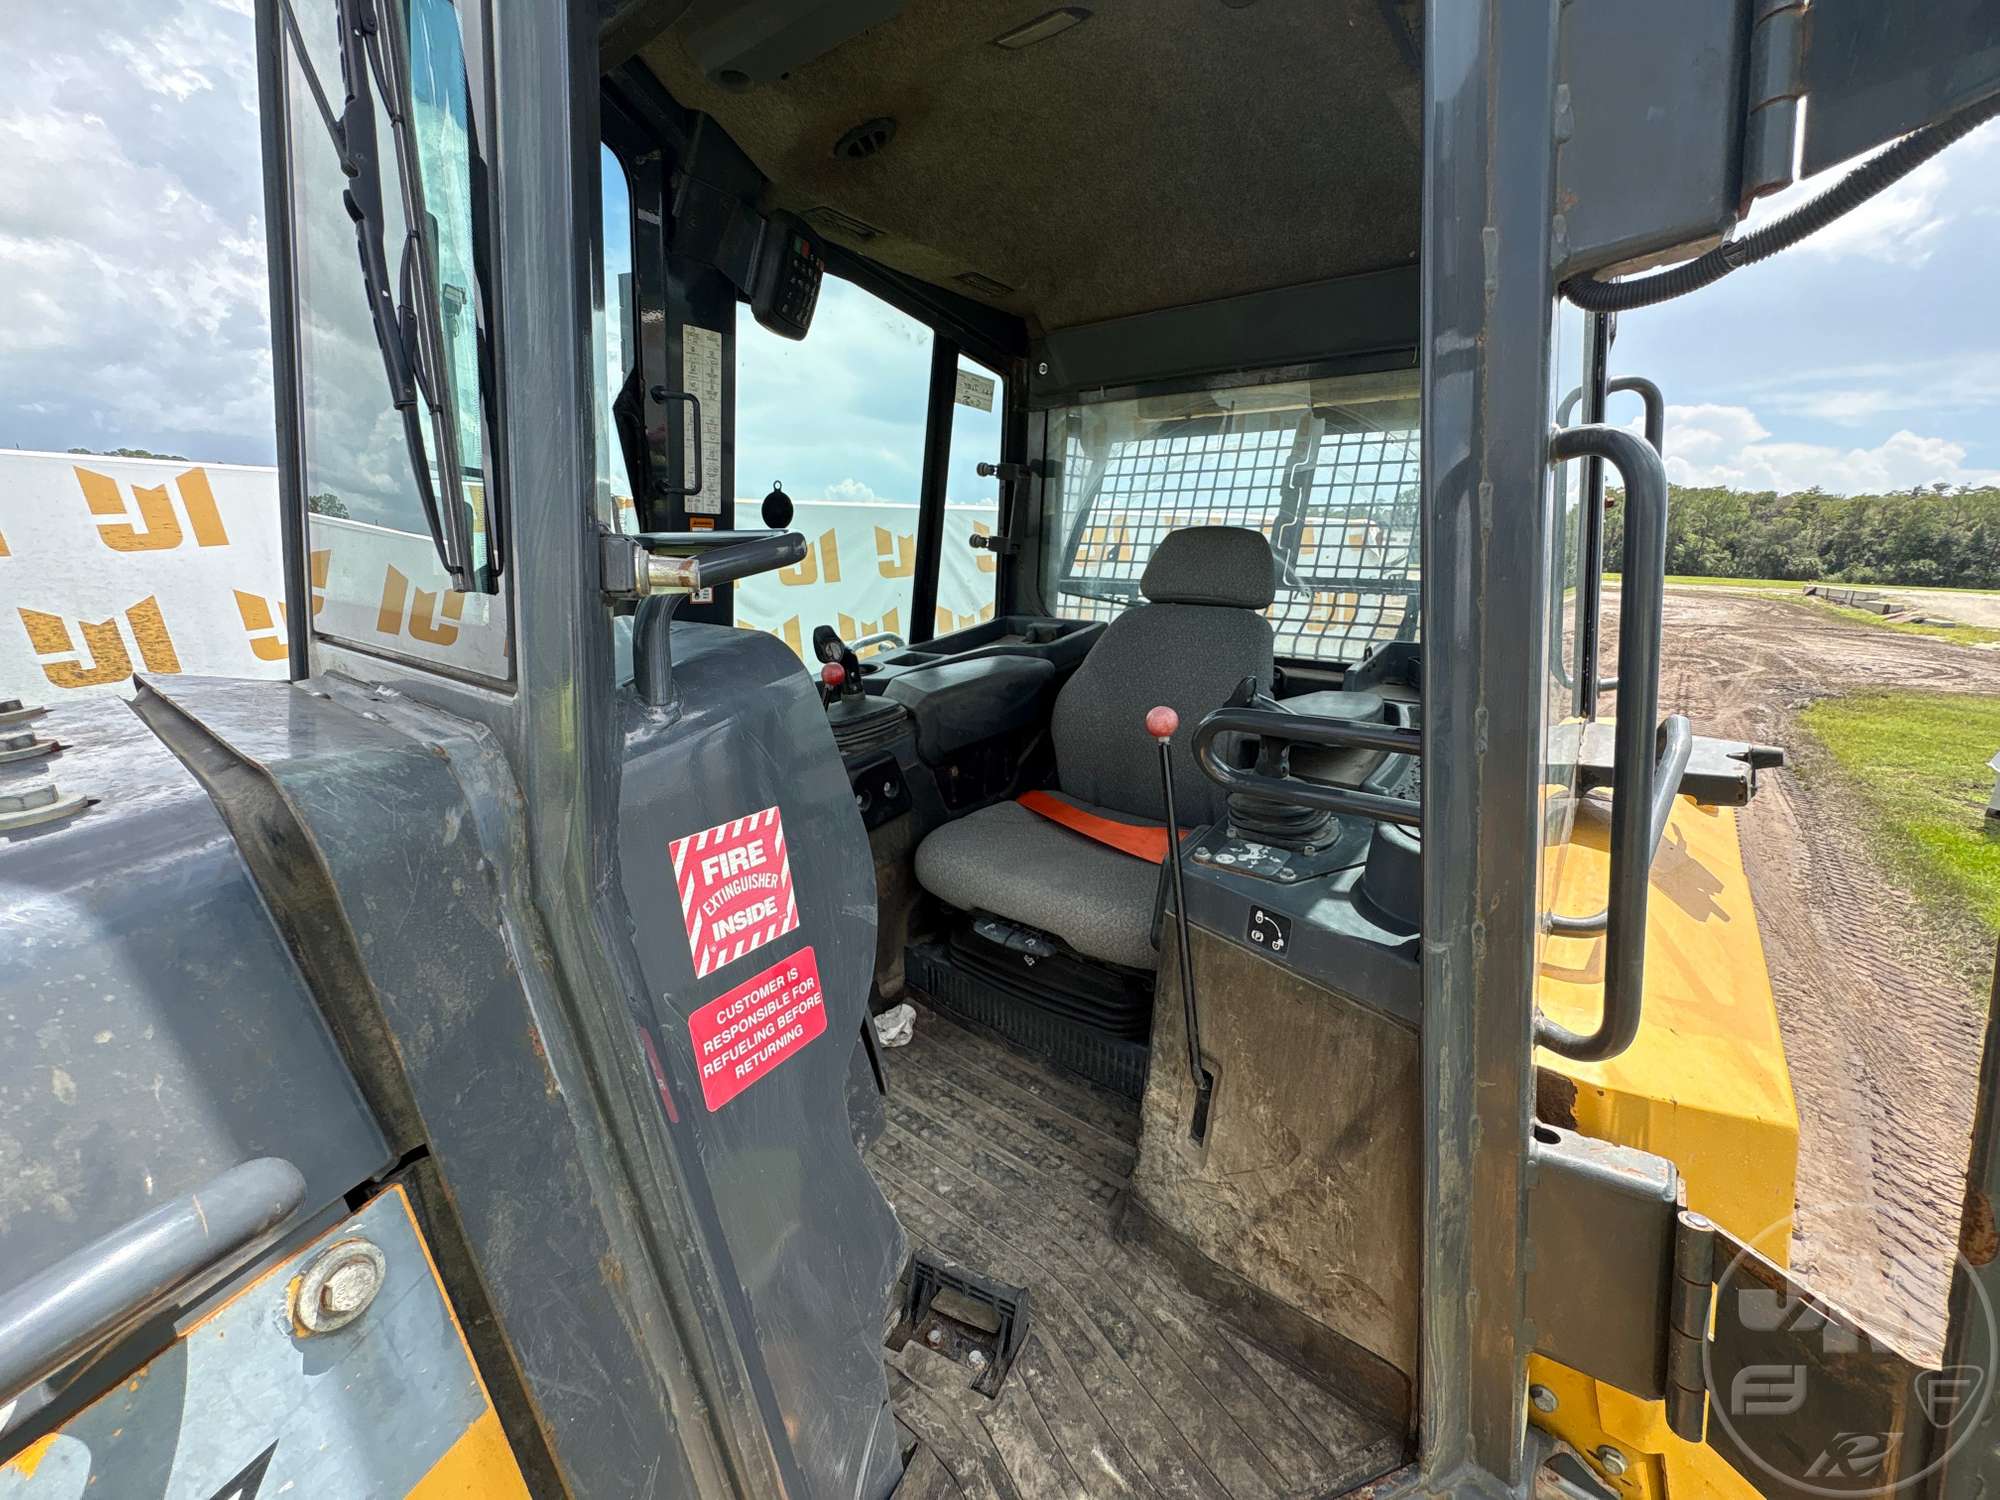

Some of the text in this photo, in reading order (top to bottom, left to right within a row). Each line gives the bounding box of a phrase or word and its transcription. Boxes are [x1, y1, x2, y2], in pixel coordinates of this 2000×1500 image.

[701, 839, 766, 886] FIRE
[702, 873, 779, 917] EXTINGUISHER
[712, 896, 777, 942] INSIDE
[703, 977, 815, 1056] RESPONSIBLE FOR
[716, 967, 799, 1025] CUSTOMER IS
[703, 991, 822, 1079] REFUELING BEFORE
[735, 1024, 804, 1079] RETURNING
